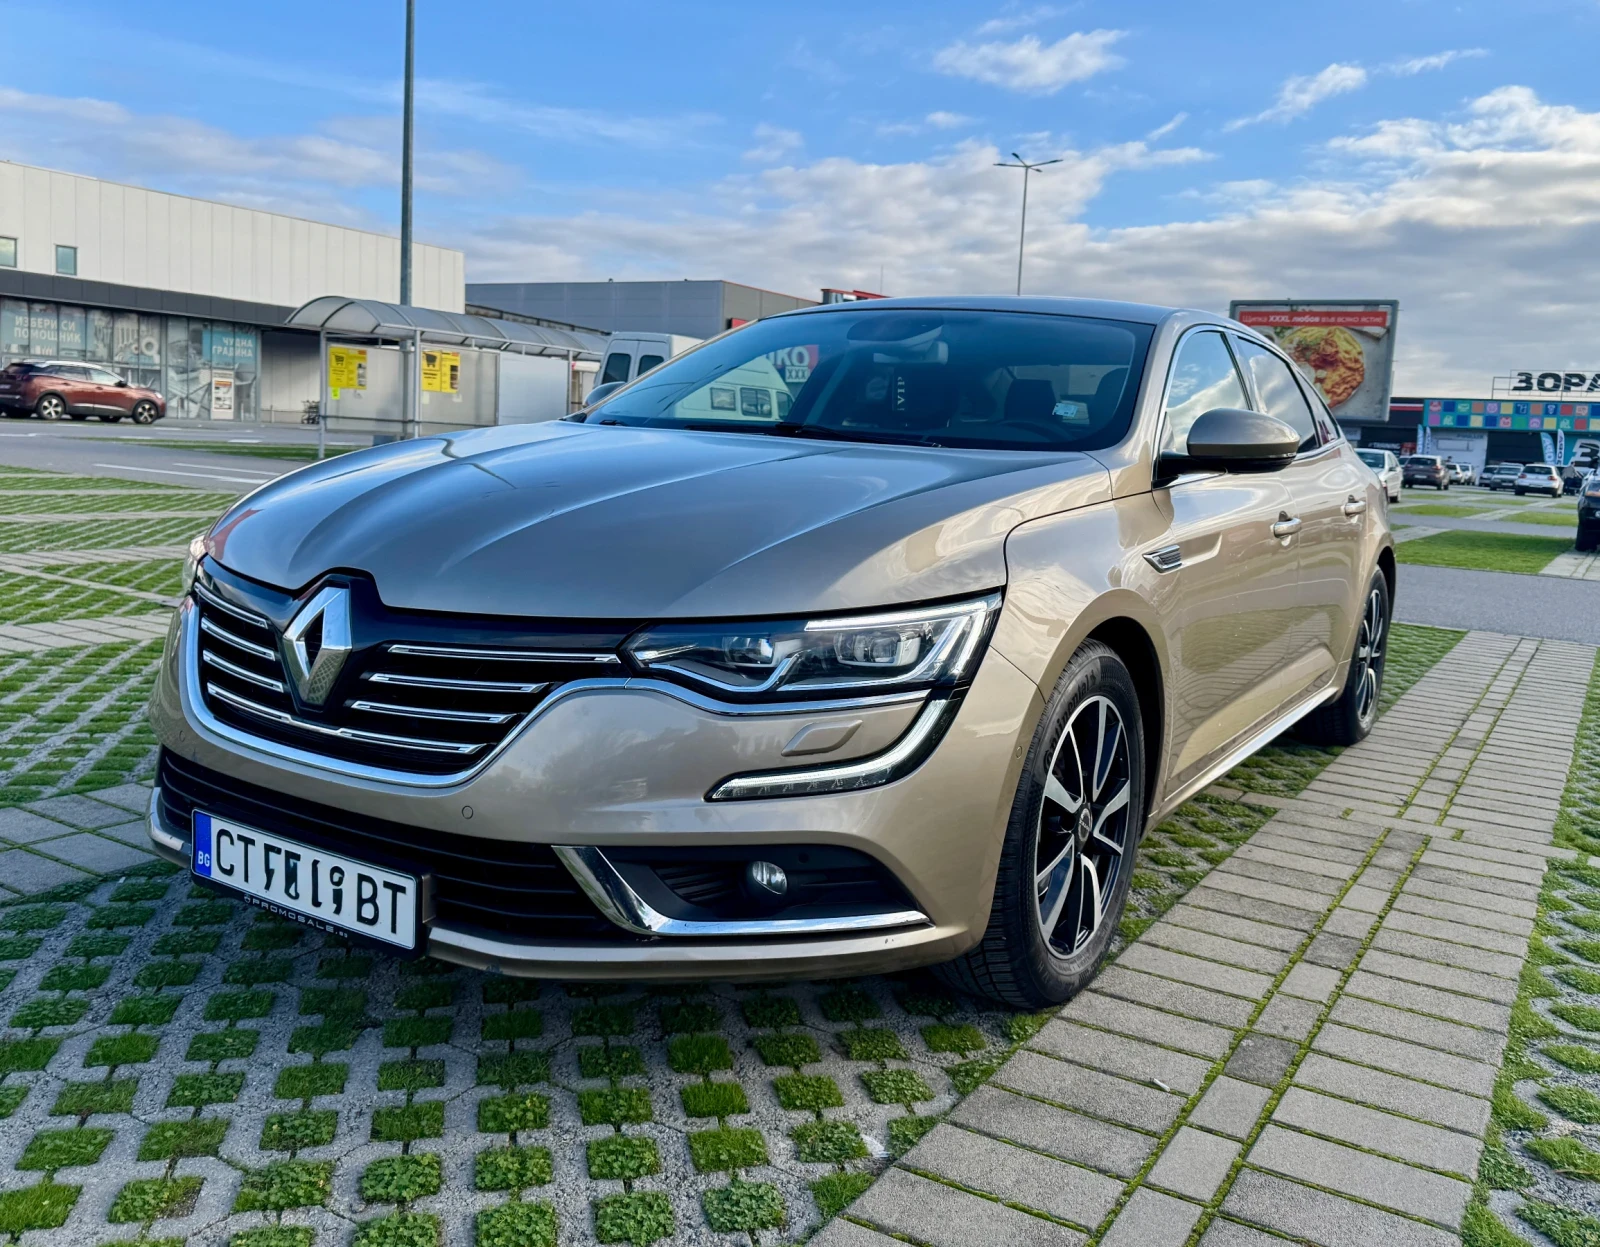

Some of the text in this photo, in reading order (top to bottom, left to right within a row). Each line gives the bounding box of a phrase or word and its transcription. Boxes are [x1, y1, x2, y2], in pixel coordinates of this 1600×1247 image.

[15, 315, 76, 331] ИЗБЕРИ СИ
[1268, 315, 1290, 323] XXXL
[1292, 314, 1320, 323] любов
[14, 327, 81, 343] ПОМОЩНИК
[222, 337, 253, 348] ЧУДНА
[212, 345, 253, 357] ГРАДИНА
[197, 850, 211, 868] BG
